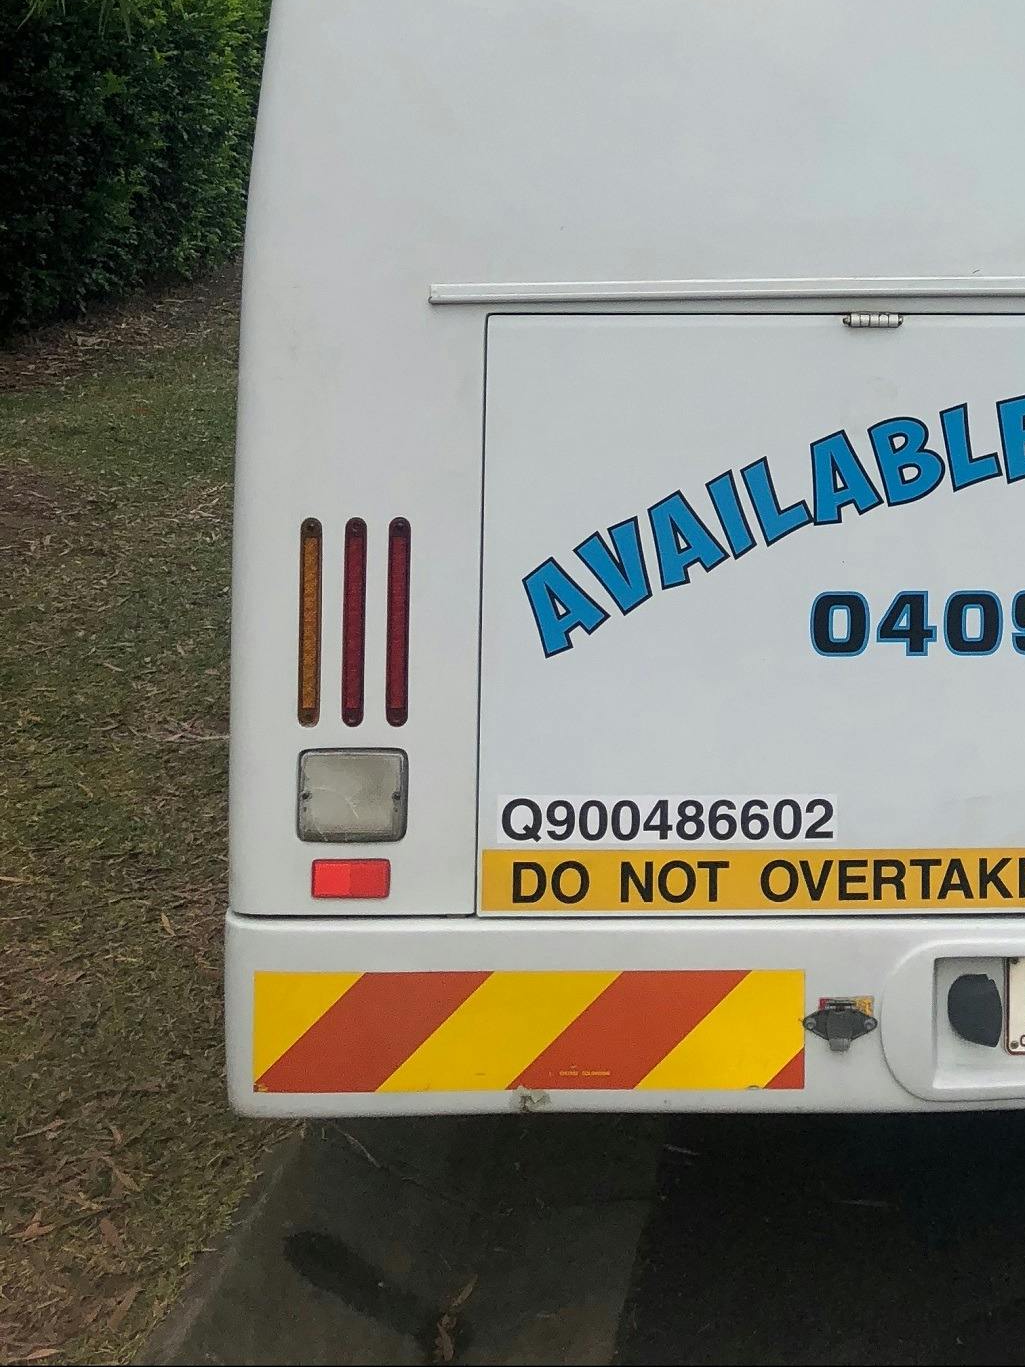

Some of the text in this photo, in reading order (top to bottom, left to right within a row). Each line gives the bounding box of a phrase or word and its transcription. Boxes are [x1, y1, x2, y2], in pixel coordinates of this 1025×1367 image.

[501, 798, 834, 842] Q900486602
[512, 860, 590, 904] DO
[620, 860, 730, 904] NOT
